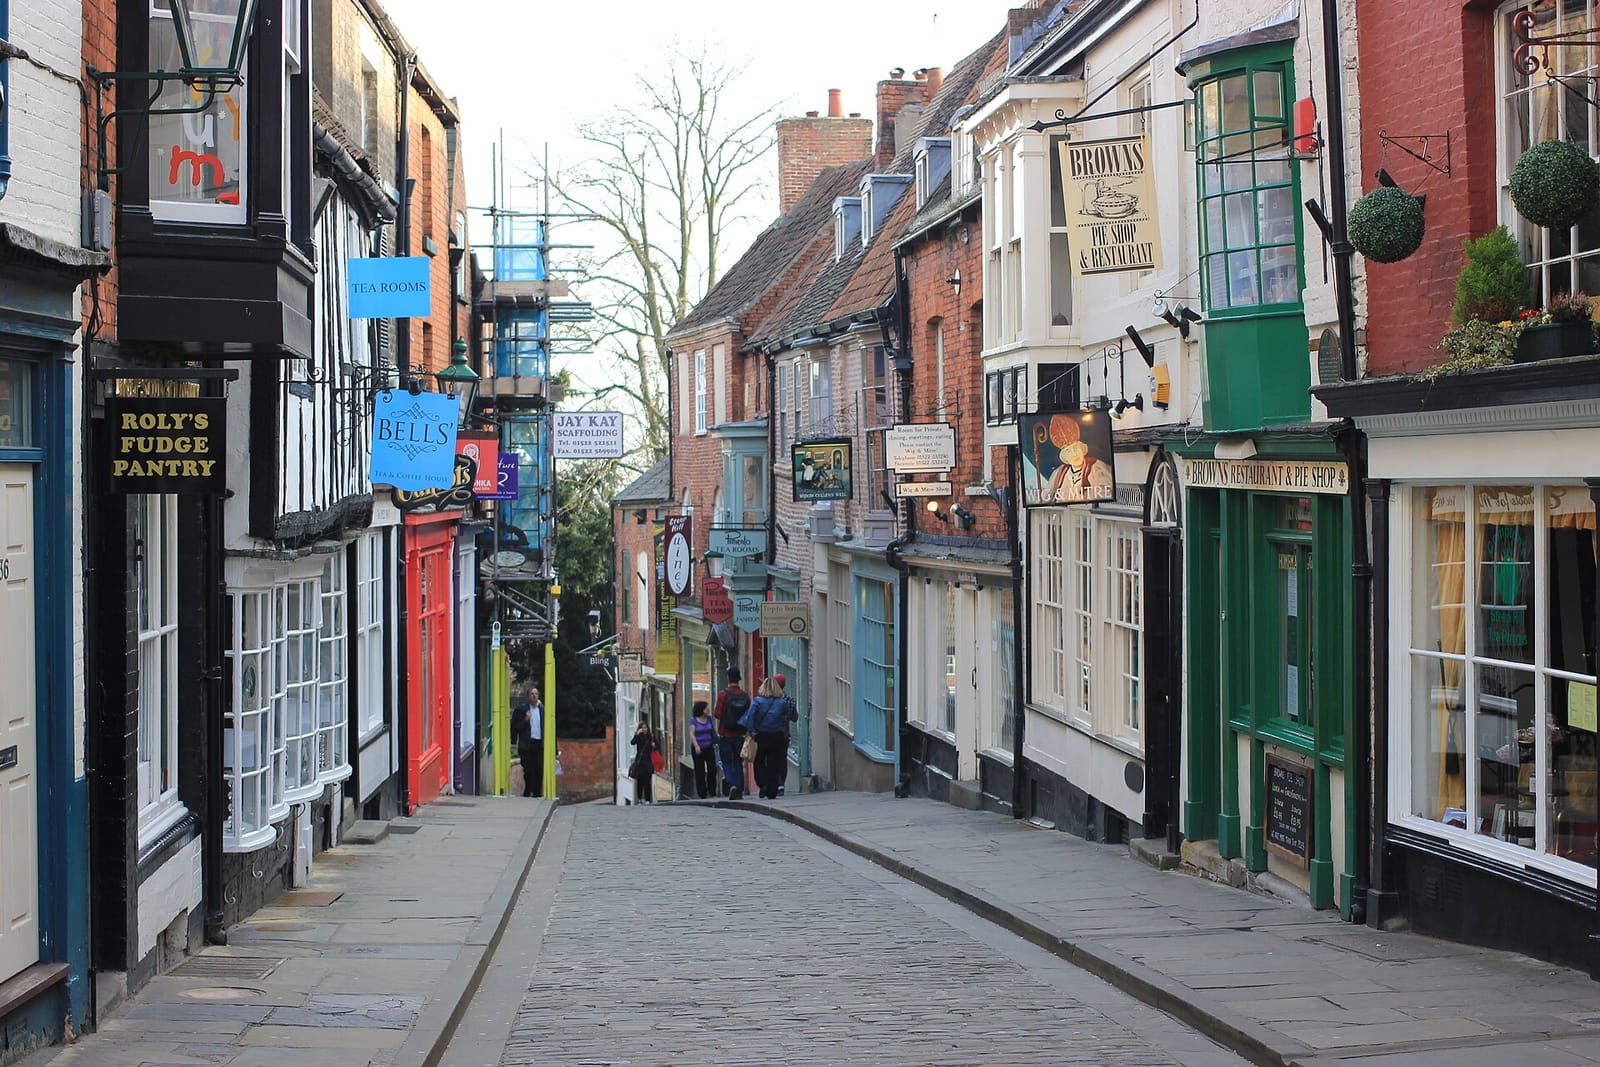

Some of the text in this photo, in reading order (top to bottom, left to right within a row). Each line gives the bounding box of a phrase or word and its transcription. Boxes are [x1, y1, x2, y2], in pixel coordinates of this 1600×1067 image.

[1069, 143, 1145, 177] BROWNS
[1091, 223, 1137, 246] PIE SHOP
[1080, 242, 1153, 269] & RESTAURANT
[351, 282, 427, 294] TEA ROOMS
[121, 413, 209, 430] ROLY'S
[557, 416, 618, 427] JAY KAY
[378, 418, 454, 446] BELLS'
[557, 429, 618, 437] SCAFFOLDING
[120, 436, 209, 453] FUDGE
[113, 460, 216, 477] PANTRY
[1192, 461, 1336, 488] BROWNS RESTAURANT & PIE SHOP
[1025, 486, 1113, 502] WIG & MITRE
[590, 656, 610, 666] Bling
